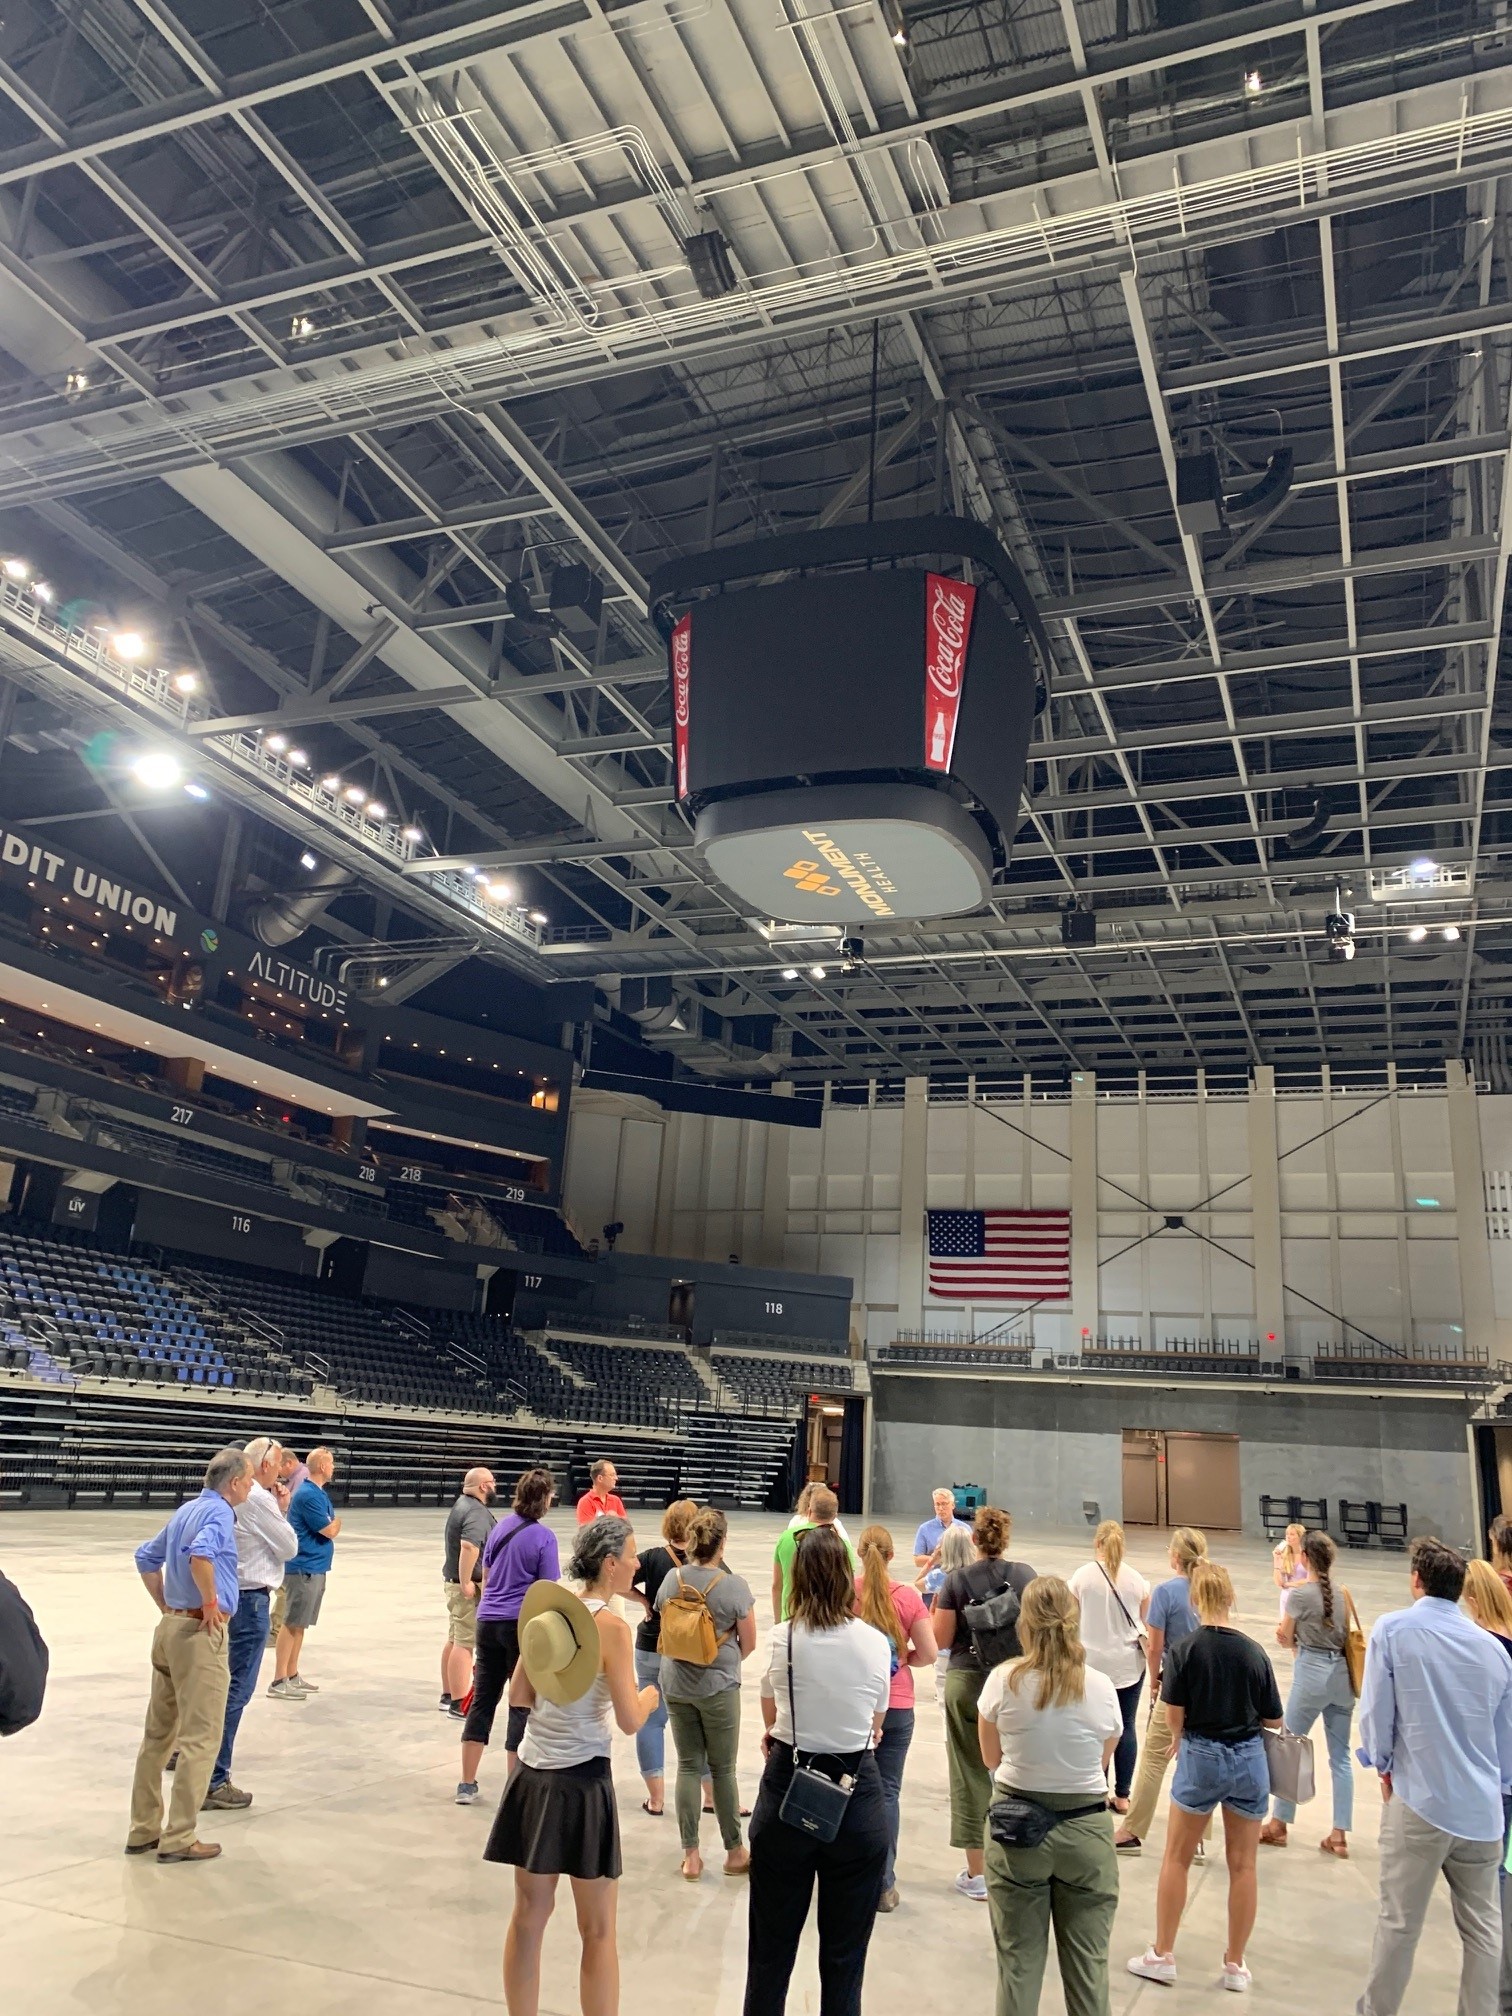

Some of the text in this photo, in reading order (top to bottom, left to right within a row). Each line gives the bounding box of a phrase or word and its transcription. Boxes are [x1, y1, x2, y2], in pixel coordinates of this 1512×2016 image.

[927, 582, 966, 698] Coca-Cola
[801, 830, 896, 917] MONUMENT
[853, 852, 898, 894] HEALTH
[0, 829, 177, 937] DIT UNION
[247, 951, 348, 1015] ALTITUDE
[170, 1106, 194, 1125] 217
[358, 1165, 376, 1182] 218
[400, 1166, 421, 1182] 218
[505, 1187, 525, 1202] 219
[232, 1216, 251, 1233] 116
[524, 1275, 542, 1289] 117
[765, 1302, 783, 1315] 118
